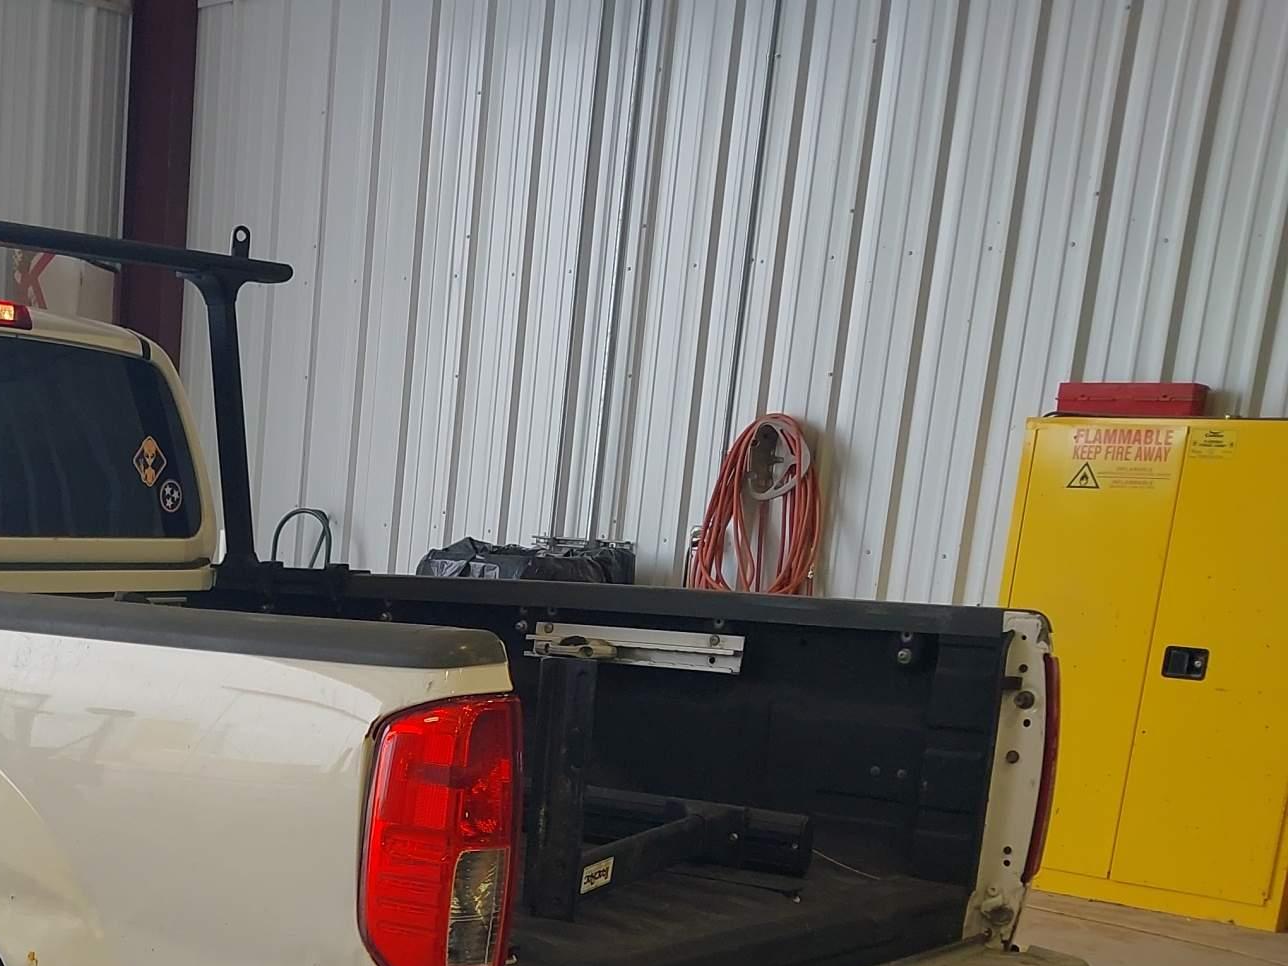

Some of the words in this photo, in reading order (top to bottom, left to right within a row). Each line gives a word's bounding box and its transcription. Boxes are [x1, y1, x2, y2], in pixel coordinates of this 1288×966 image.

[1075, 428, 1174, 446] FLAMMABLE
[1073, 445, 1101, 460] KEEP
[1104, 446, 1132, 461] FIRE
[1135, 446, 1172, 462] AWAY
